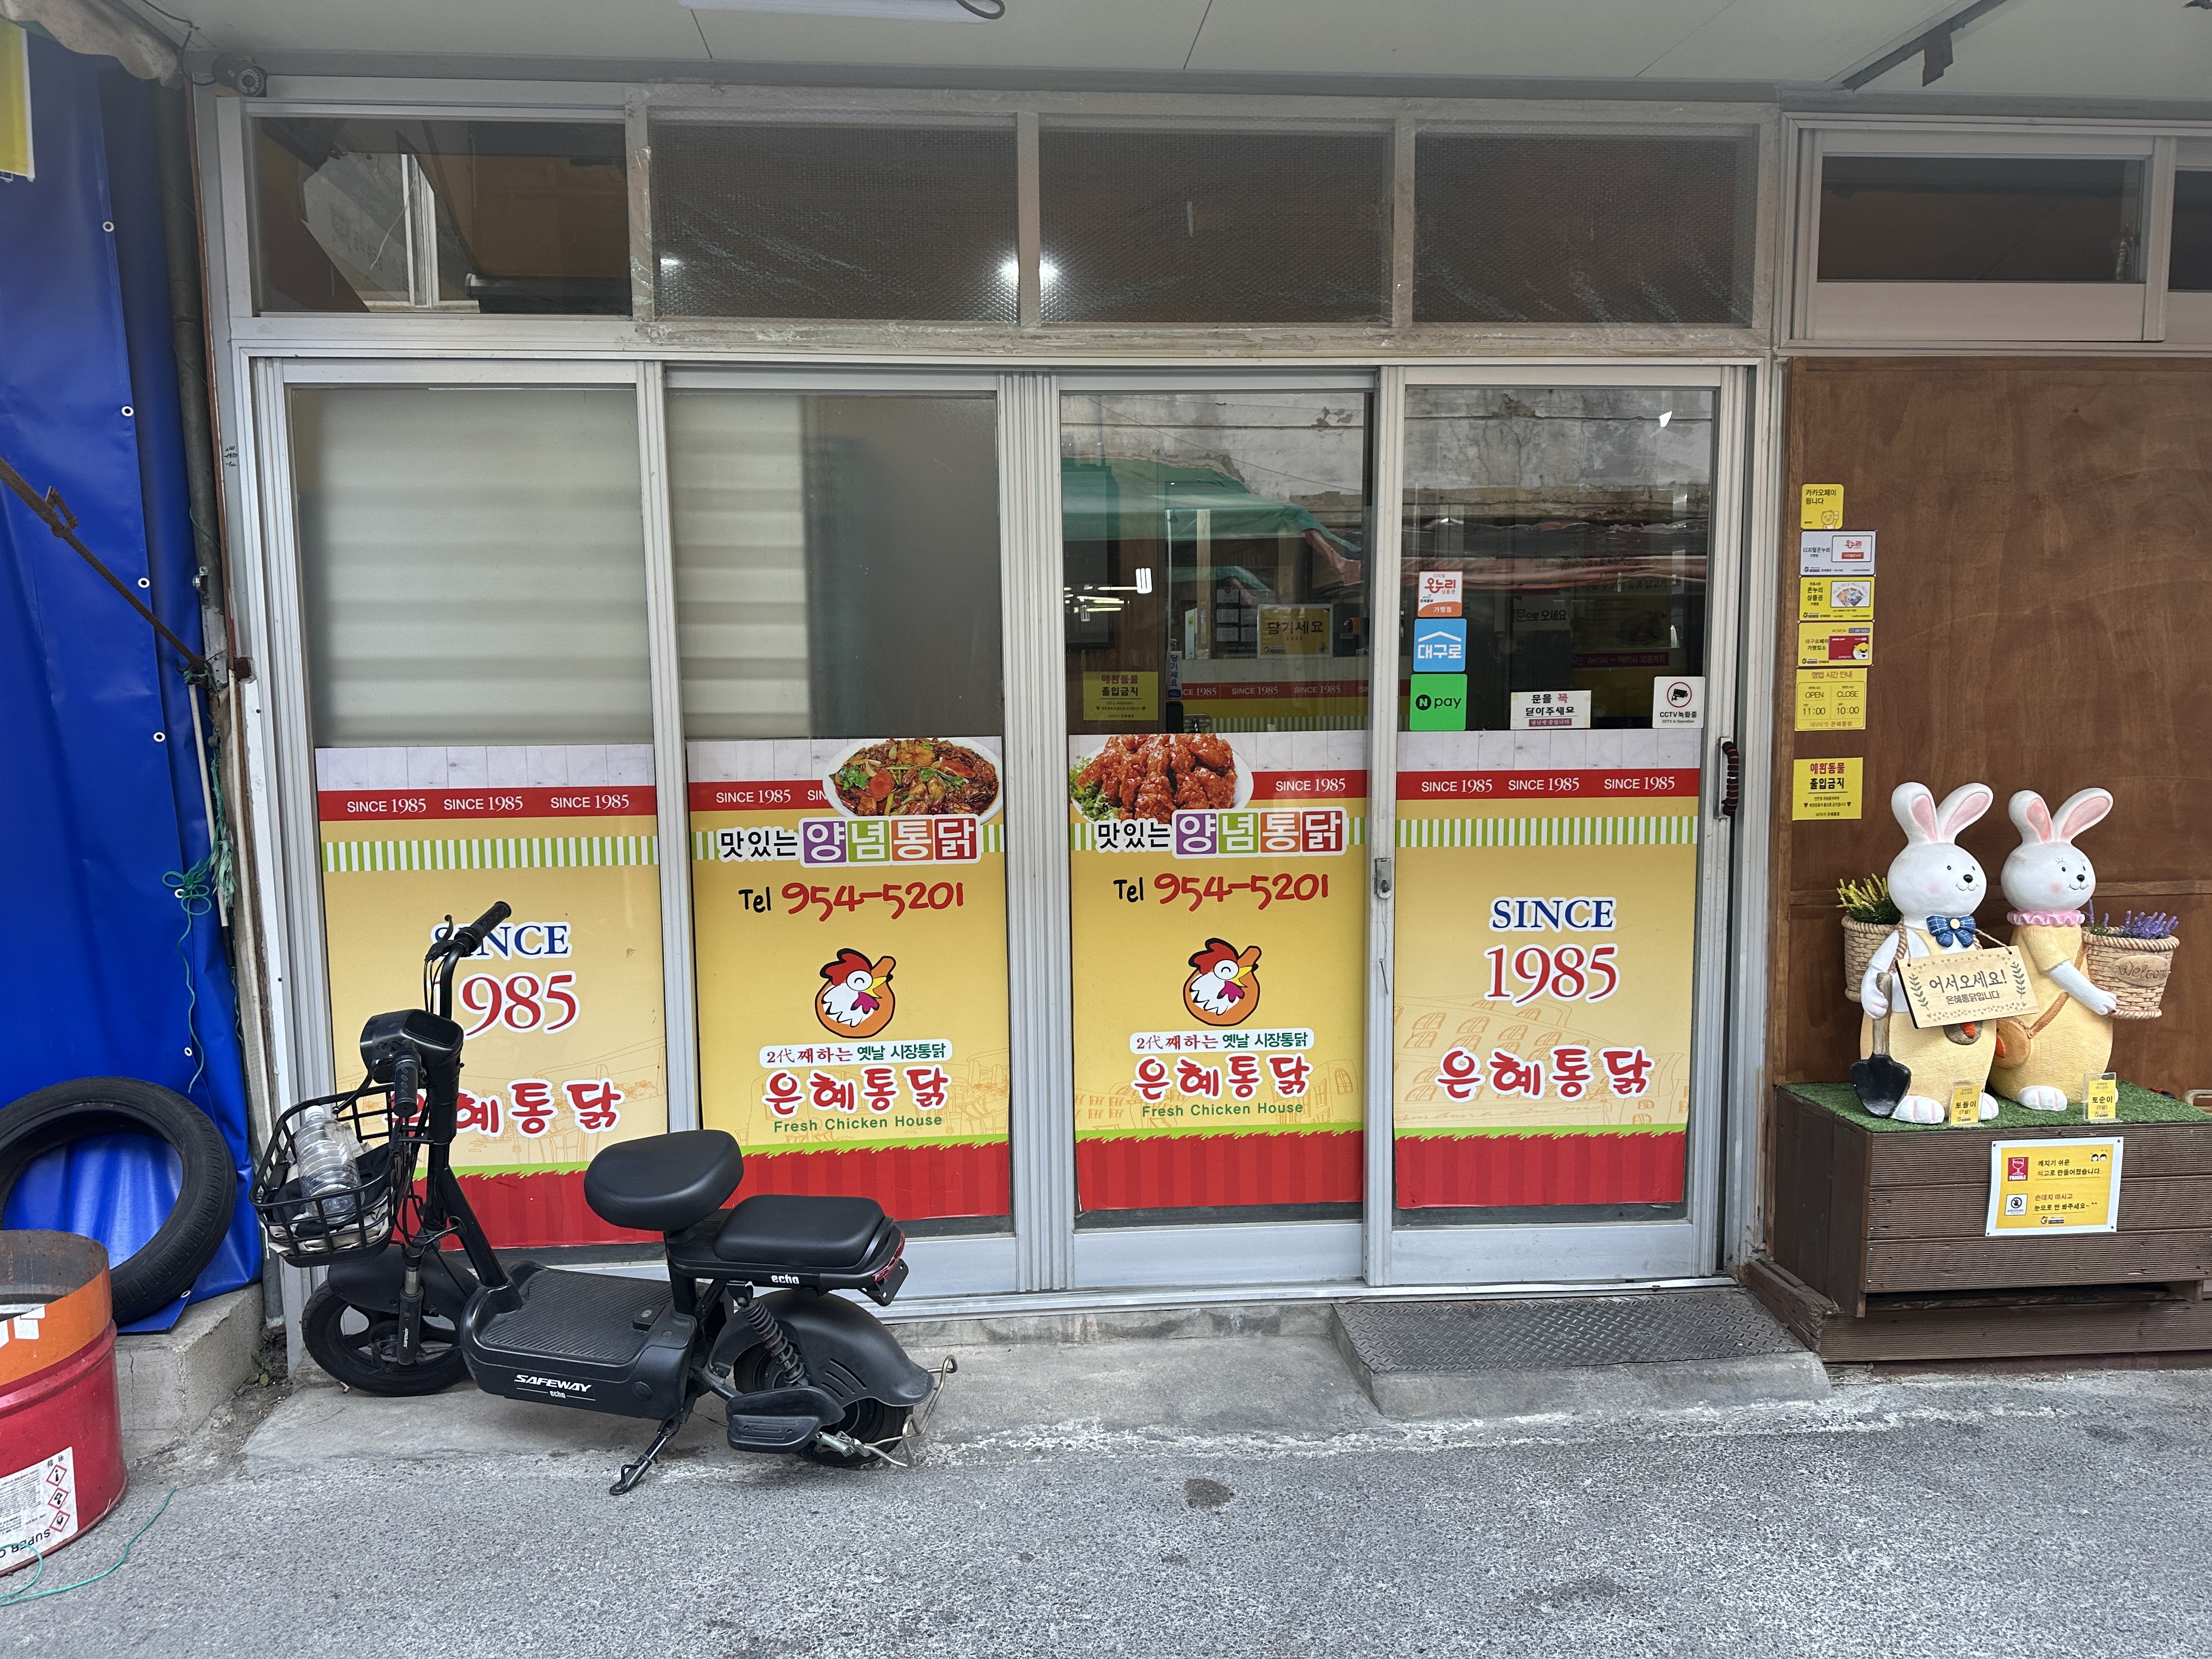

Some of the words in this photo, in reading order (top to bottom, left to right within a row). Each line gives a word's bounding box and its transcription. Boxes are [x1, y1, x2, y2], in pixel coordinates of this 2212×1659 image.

[1424, 578, 1456, 594] 온누리
[1513, 609, 1539, 622] 문으로
[1542, 609, 1567, 621] 오세요
[1267, 620, 1324, 635] 당기세요
[1417, 644, 1462, 659] 대구로
[1170, 654, 1178, 686] 당기세요
[1102, 675, 1139, 684] 애완동물
[1102, 687, 1138, 696] 출입금지
[1196, 687, 1217, 697] 1985
[1232, 687, 1256, 695] SINCE
[1257, 686, 1278, 696] 1985
[1319, 685, 1341, 695] 1985
[1434, 696, 1462, 709] pay
[1532, 694, 1552, 704] 문을
[1557, 693, 1568, 703] 꼭
[1525, 706, 1575, 716] 닫아주세요
[1837, 706, 1859, 714] 10:00
[1810, 762, 1845, 774] 애완동물
[1276, 781, 1311, 792] SINCE
[1314, 778, 1346, 792] 1985
[1421, 781, 1458, 792] SINCE
[1460, 778, 1493, 794] 1985
[1508, 779, 1544, 791] SINCE
[1548, 777, 1579, 792] 1985
[1604, 777, 1640, 790] SINCE
[1643, 775, 1675, 791] 1985
[1809, 777, 1844, 790] 출입금지
[443, 799, 484, 811] SINCE
[488, 796, 523, 812] 1985
[550, 797, 591, 809] SINCE
[594, 794, 630, 810] 1985
[716, 792, 754, 803] SINCE
[758, 789, 791, 804] 1985
[347, 801, 387, 813] SINCE
[391, 798, 427, 815] 1985
[721, 830, 797, 858] 맛있는
[806, 820, 973, 861] 양념통닭
[1098, 822, 1169, 849] 맛있는
[1179, 813, 1341, 853] 양념통닭
[1113, 877, 1144, 902] Tel
[1154, 873, 1329, 912] 954-5201
[738, 887, 771, 913] Tel
[782, 882, 964, 922] 954-5201
[1492, 900, 1613, 929] SINCE
[433, 925, 569, 957] NCE
[1487, 946, 1617, 1003] 1985
[2114, 962, 2170, 979] Welcom
[1929, 969, 2007, 995] 어서오세요!
[434, 974, 576, 1036] 985
[1946, 990, 2000, 1005] 은혜통닭입니다
[1223, 1034, 1250, 1048] 옛날
[1254, 1032, 1308, 1047] 시장통닭
[857, 1046, 885, 1061] 옛날
[890, 1043, 946, 1060] 시장통닭
[1135, 1056, 1310, 1100] 은혜통닭
[1438, 1048, 1652, 1099] 은혜통닭
[765, 1067, 949, 1115] 은혜통닭
[1142, 1105, 1183, 1117] Fresh
[1190, 1103, 1251, 1115] Chicken
[1257, 1102, 1304, 1114] House
[774, 1119, 818, 1133] Fresh
[825, 1117, 888, 1130] Chicken
[895, 1115, 942, 1128] House
[771, 1274, 799, 1285] echo
[514, 1374, 593, 1393] SAFEWAY
[549, 1389, 566, 1399] echo
[12, 1528, 50, 1553] SUPER
